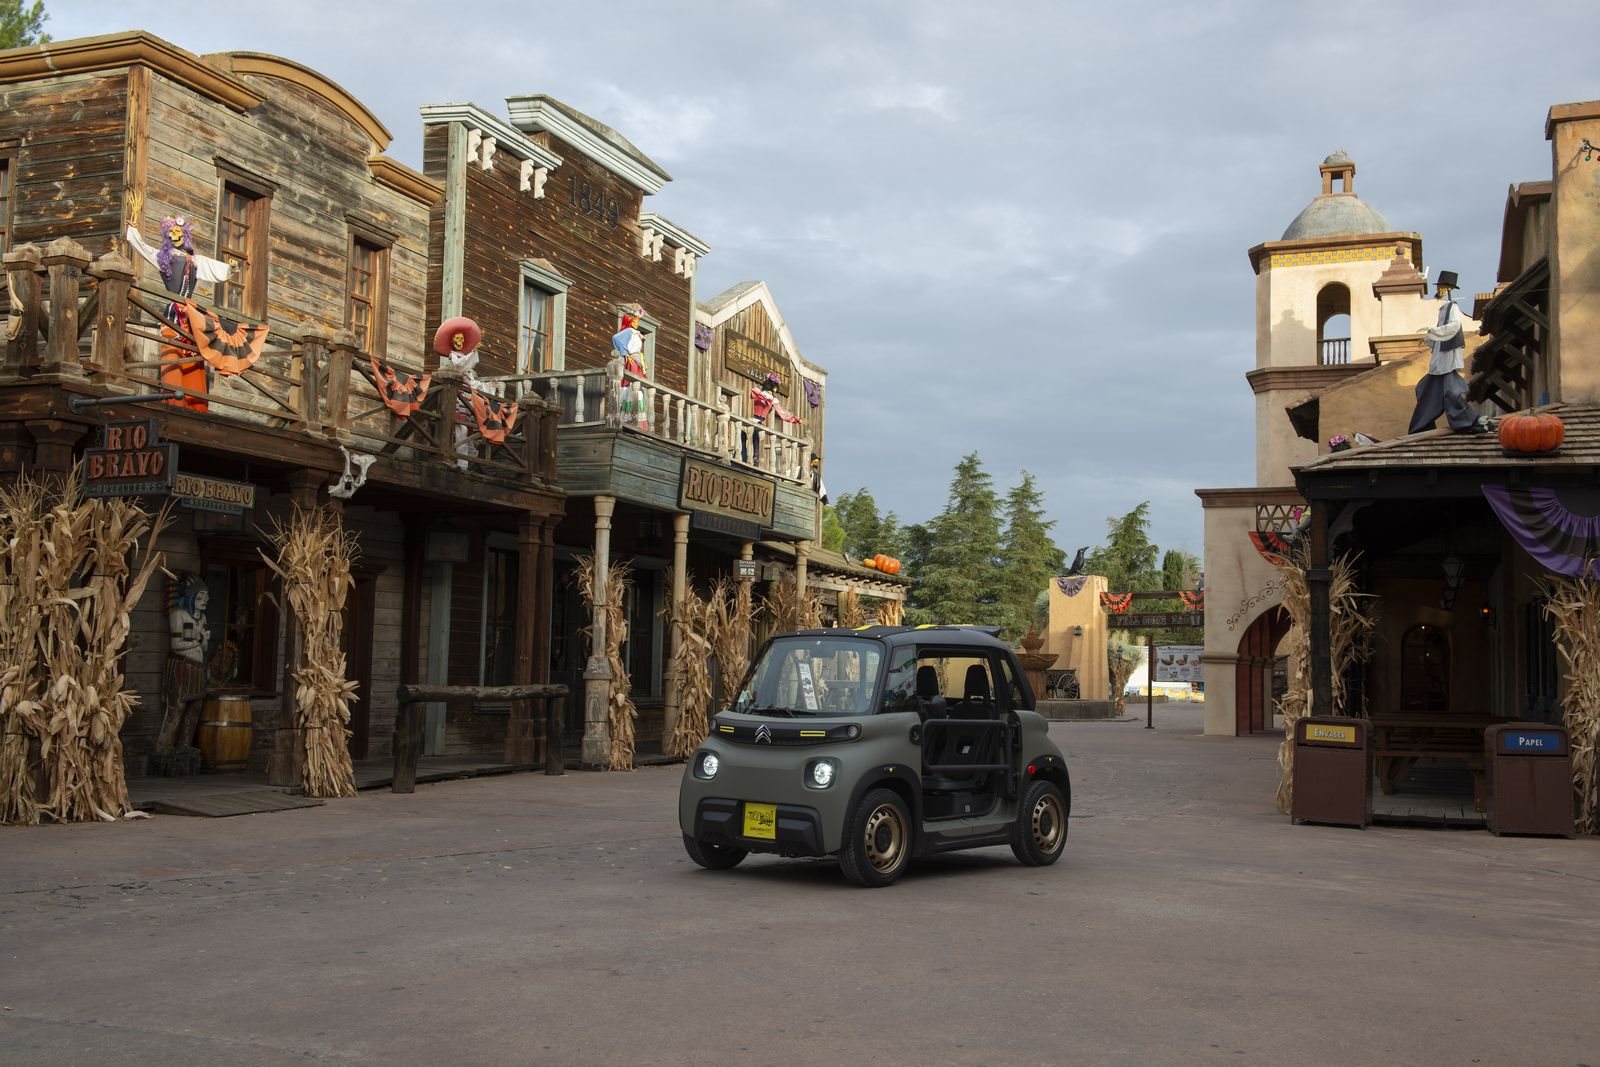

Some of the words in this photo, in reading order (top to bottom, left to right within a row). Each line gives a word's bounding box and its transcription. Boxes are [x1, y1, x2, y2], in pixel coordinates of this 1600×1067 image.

[106, 425, 147, 450] RIO
[88, 451, 164, 479] BRAVO
[174, 476, 200, 496] RIO
[203, 480, 252, 504] BRAVO
[686, 466, 718, 505] RIO
[719, 476, 770, 518] BRAVO
